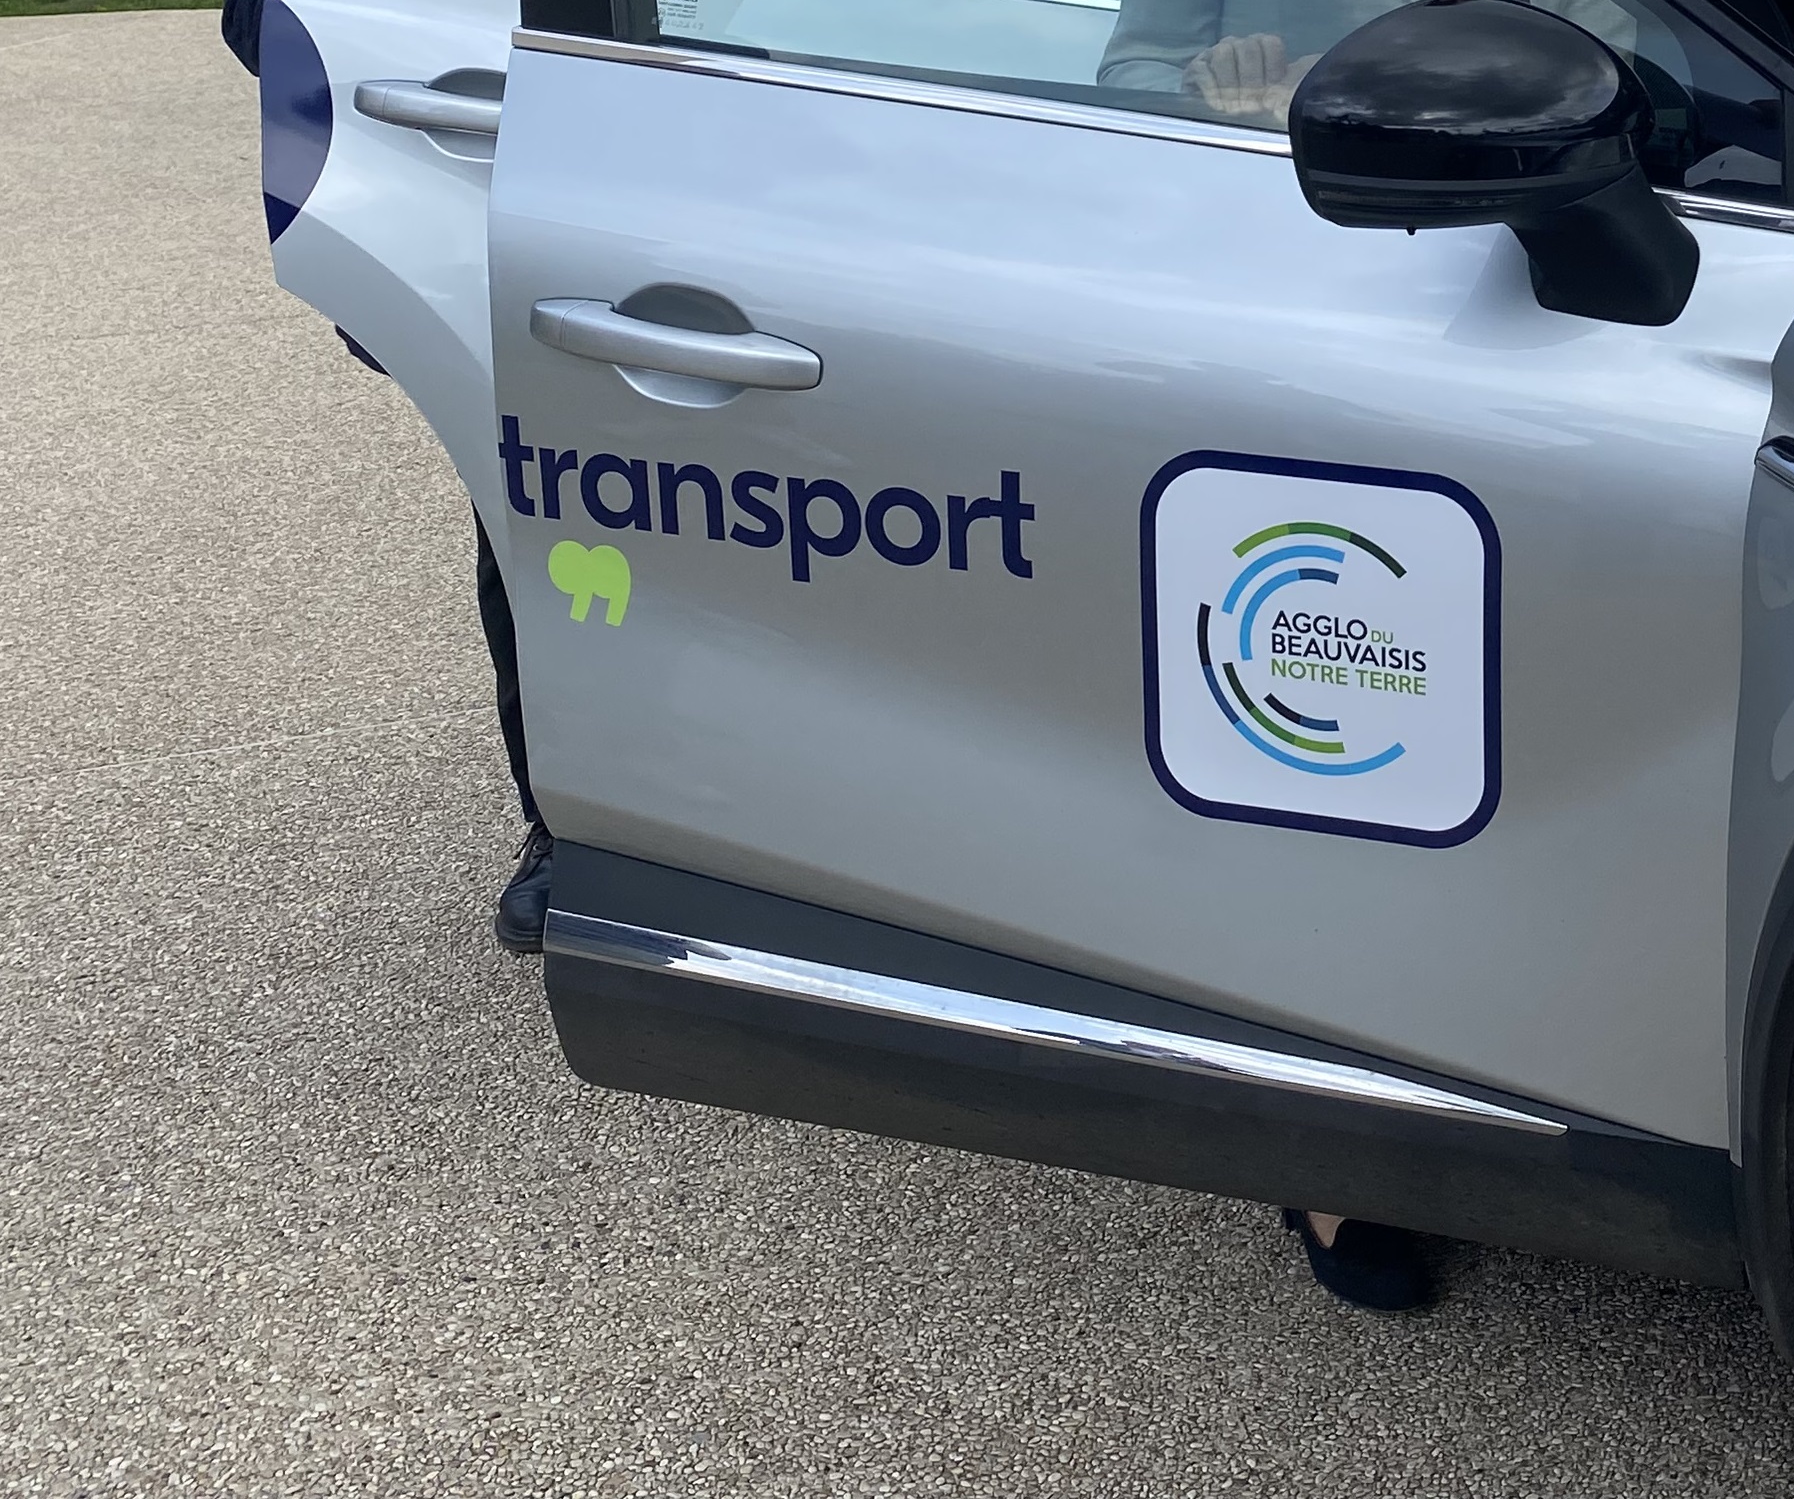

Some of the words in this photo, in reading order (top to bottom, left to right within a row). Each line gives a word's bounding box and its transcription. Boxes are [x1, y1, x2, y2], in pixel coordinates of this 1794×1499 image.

[499, 414, 1035, 583] transport
[1271, 610, 1368, 640] AGGLO
[1371, 630, 1394, 644] DU
[1271, 633, 1427, 672] BEAUVAISIS
[1271, 658, 1349, 685] NOTRE
[1355, 669, 1427, 695] TERRE
